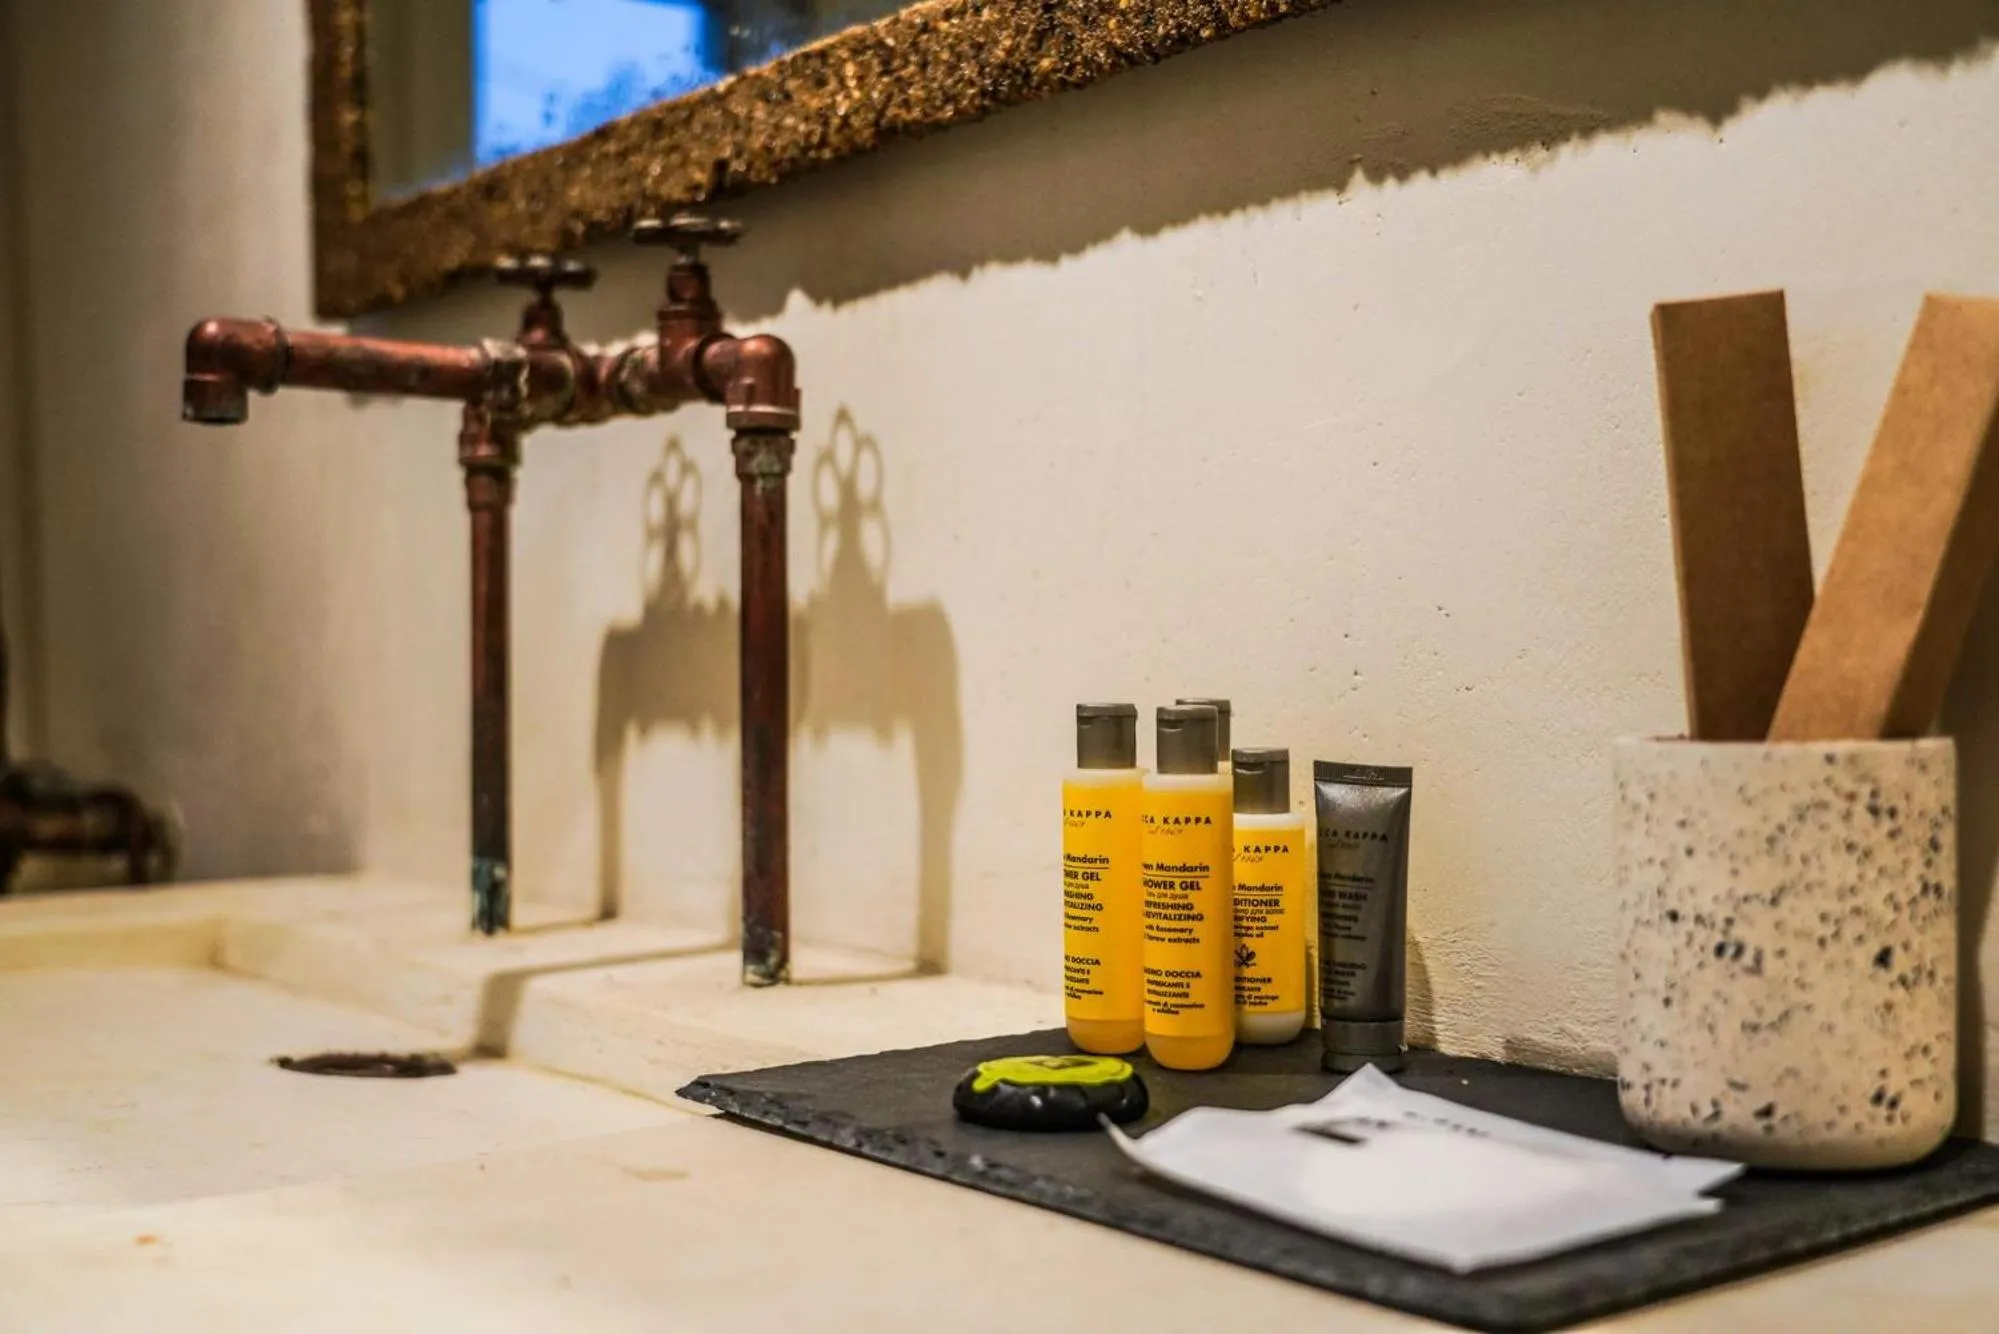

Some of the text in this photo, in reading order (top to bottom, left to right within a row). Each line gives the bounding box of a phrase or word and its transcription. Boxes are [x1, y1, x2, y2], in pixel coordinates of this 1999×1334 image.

[1069, 809, 1112, 819] KAPPA
[1162, 815, 1212, 825] KAPPA
[1344, 829, 1388, 843] KAPPA
[1243, 845, 1289, 853] KAPPA
[1066, 853, 1110, 865] Mandarin
[1155, 861, 1210, 873] Mandarin
[1081, 871, 1102, 882] GEL
[1178, 880, 1203, 891] GEL
[1238, 883, 1284, 893] Mandarin
[1071, 956, 1102, 966] DOCCIA
[1164, 970, 1203, 979] DOCCIA
